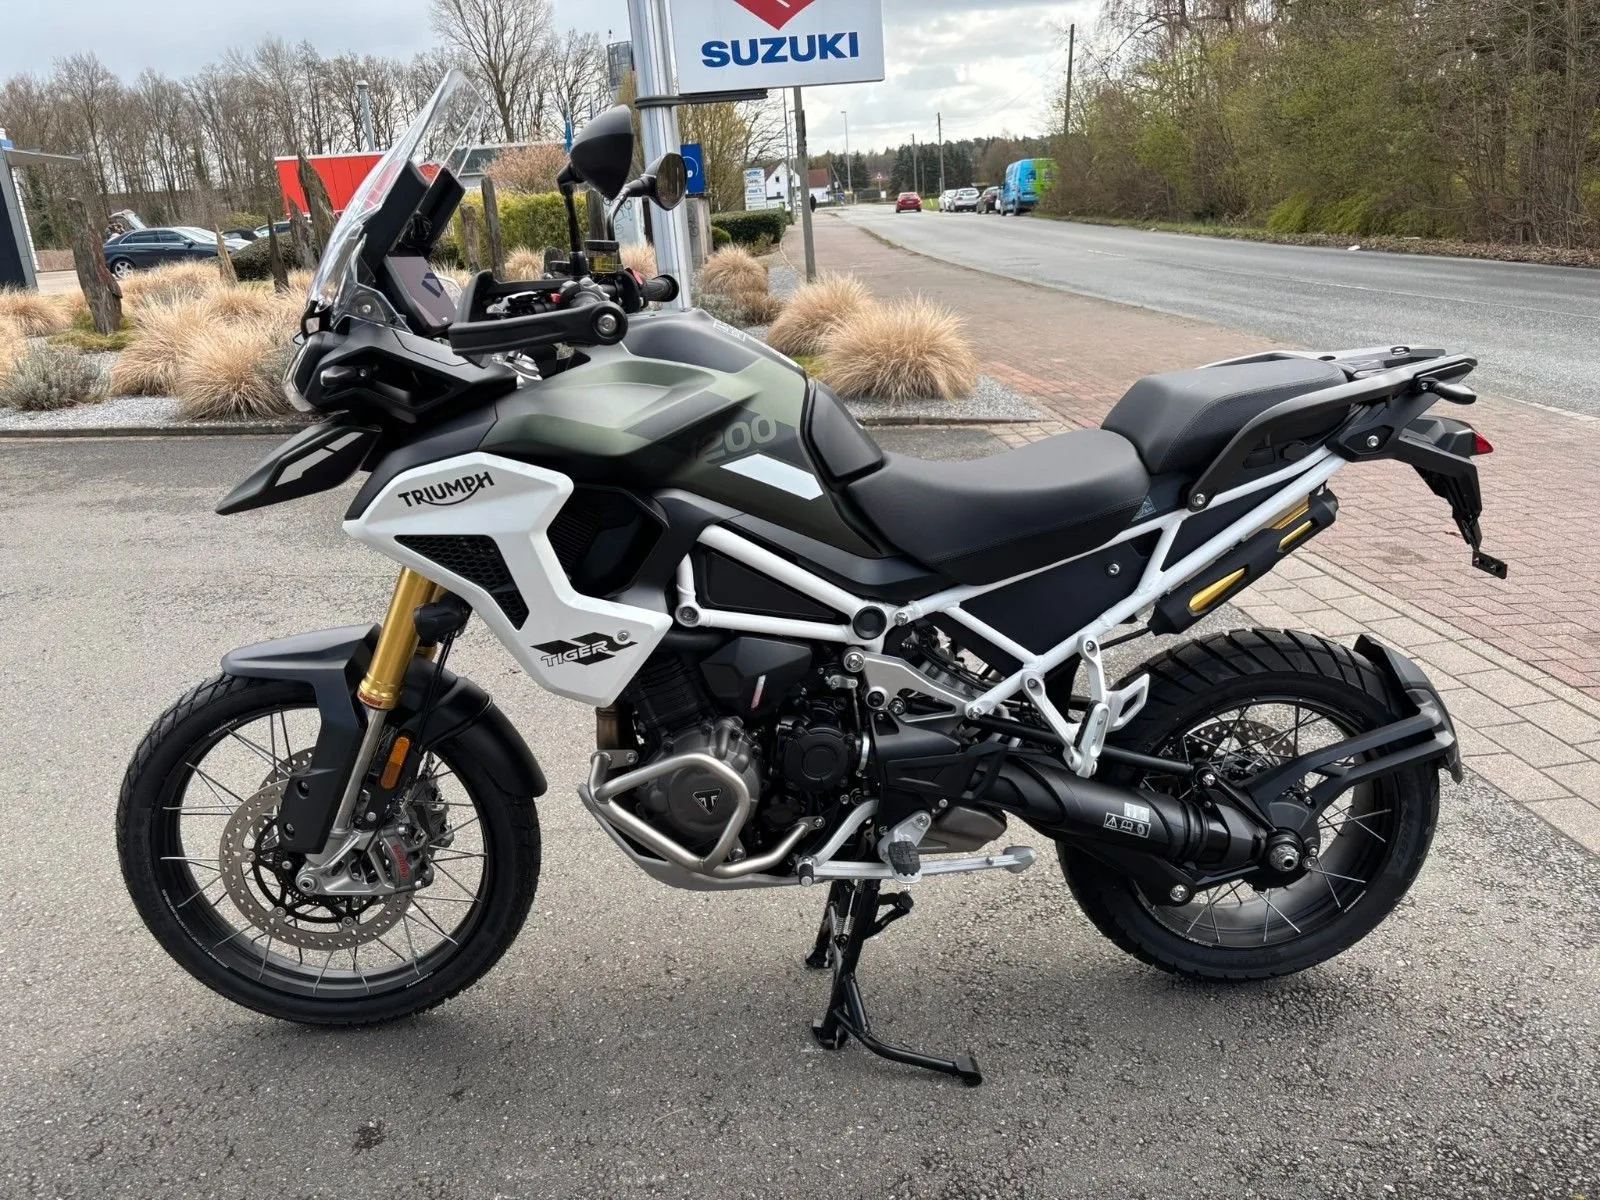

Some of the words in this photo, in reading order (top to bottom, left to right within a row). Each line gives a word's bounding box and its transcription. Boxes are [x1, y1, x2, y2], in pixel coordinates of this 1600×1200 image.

[701, 32, 859, 67] SUZUKI
[693, 415, 777, 459] 200
[398, 471, 494, 507] TRIUMPH
[541, 640, 608, 667] TIGER
